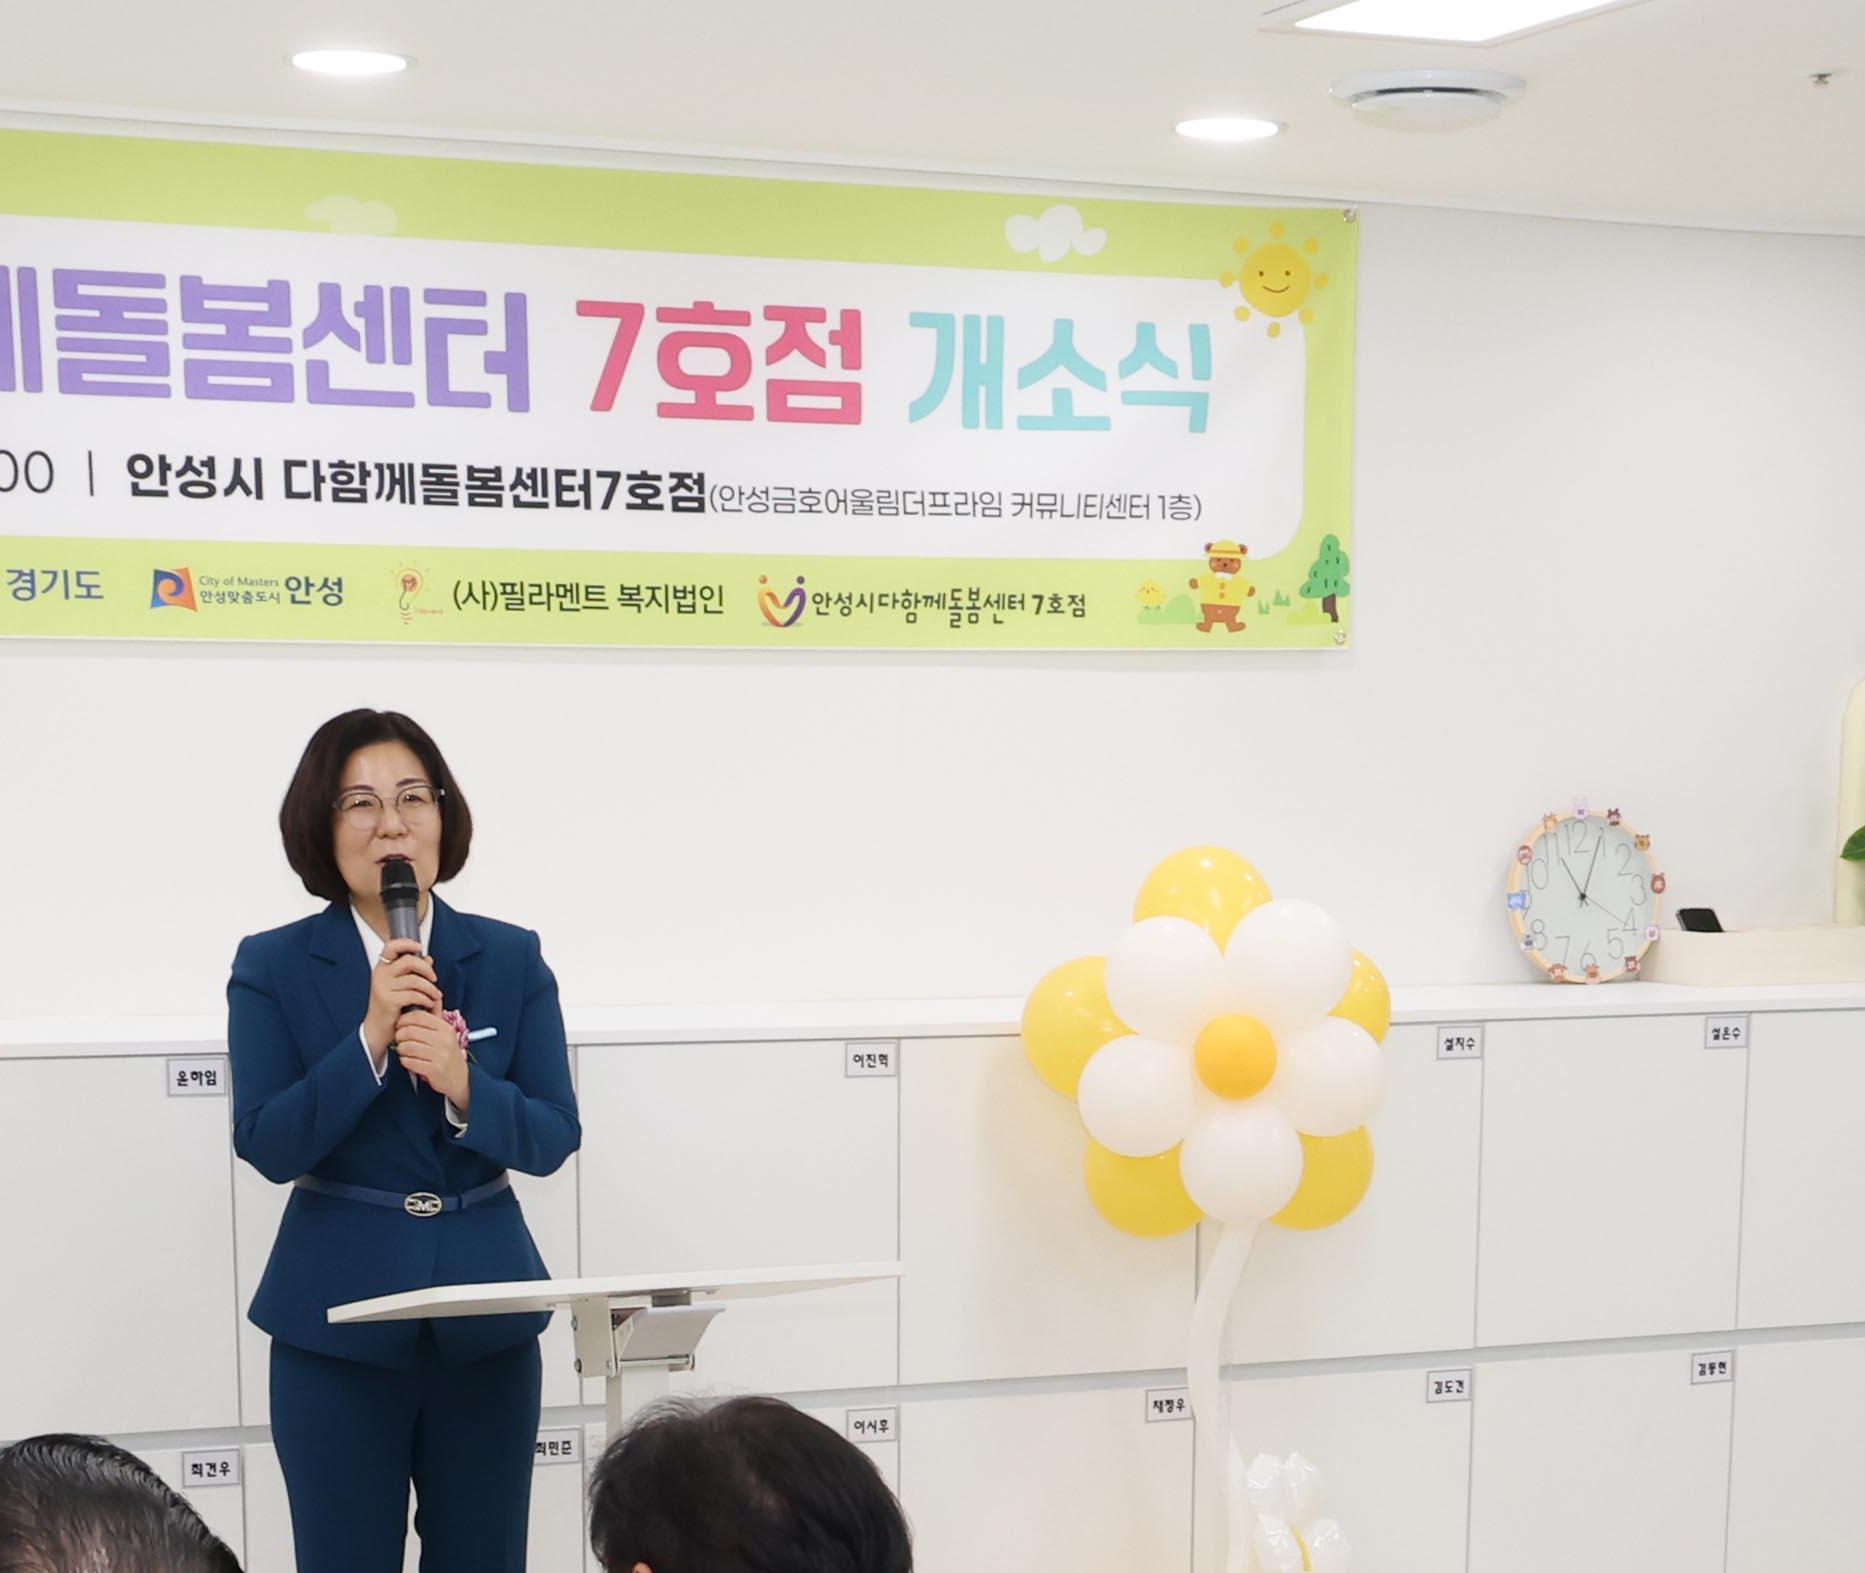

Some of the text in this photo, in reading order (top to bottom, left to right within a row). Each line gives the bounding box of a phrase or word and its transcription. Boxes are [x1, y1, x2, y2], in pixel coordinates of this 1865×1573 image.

[576, 300, 862, 425] 7호점
[910, 309, 1214, 433] 개소식
[127, 454, 263, 500] 안성시
[1012, 493, 1149, 519] 커뮤니티센터
[1158, 494, 1201, 520] 1층)
[7, 569, 103, 601] 경기도
[200, 576, 218, 587] City
[238, 578, 278, 586] Masters
[285, 576, 343, 606] 안성
[201, 591, 280, 604] 안성맞춤도시
[454, 581, 723, 614] (사)필라멘트 복지법인
[812, 588, 1085, 628] 안성시다함께돌봄센터 7호점
[1564, 820, 1590, 856] 12
[1615, 842, 1633, 877] 2
[1630, 874, 1647, 906] 3
[1622, 907, 1639, 936] 4
[1554, 935, 1570, 965] 7
[1607, 928, 1624, 960] 5
[853, 1054, 888, 1068] 이진혁
[854, 1419, 888, 1434] 이시후
[535, 1441, 572, 1457] 최민준
[192, 1462, 230, 1477] 최건우
